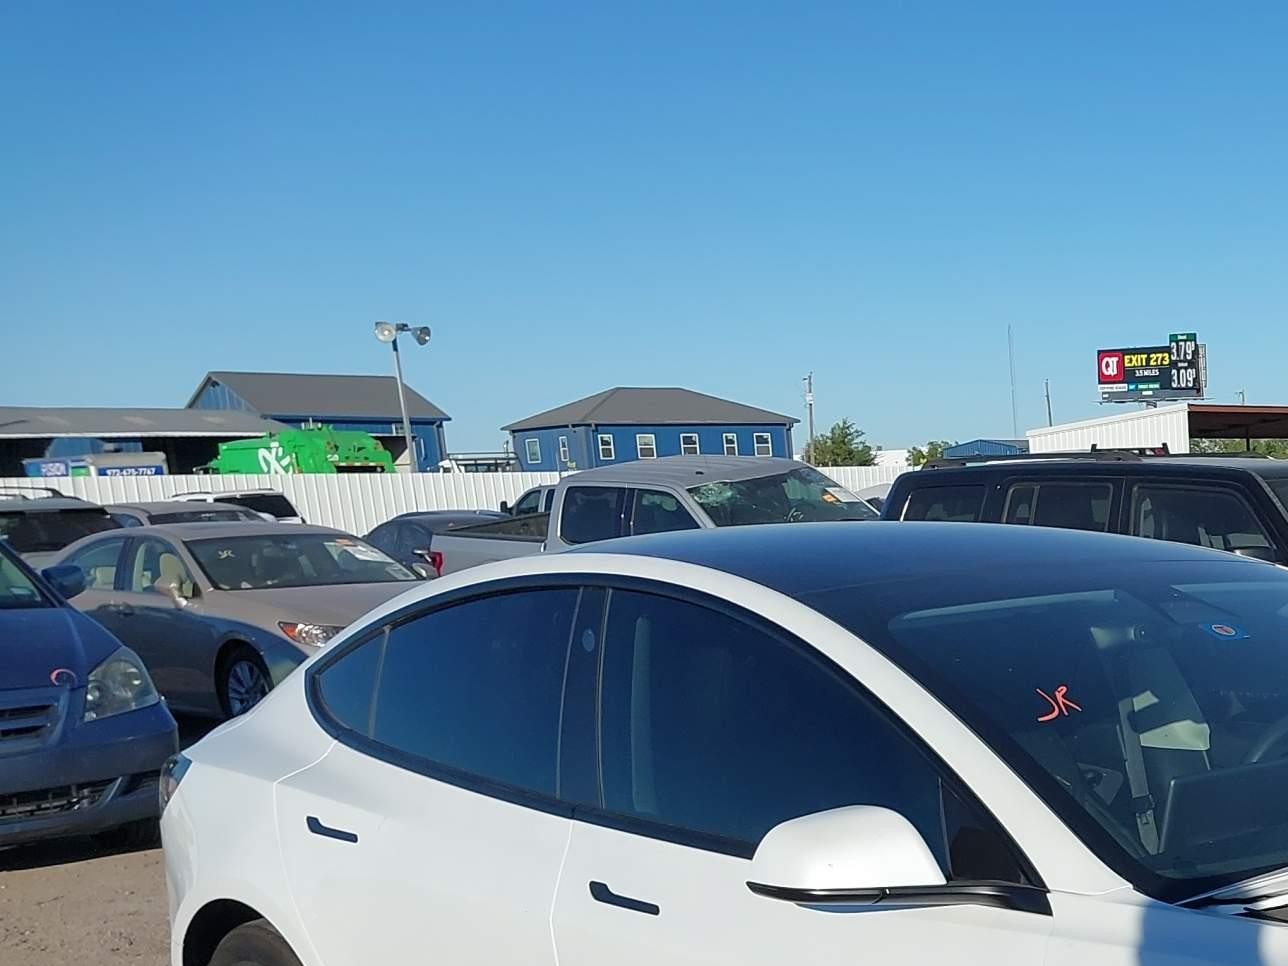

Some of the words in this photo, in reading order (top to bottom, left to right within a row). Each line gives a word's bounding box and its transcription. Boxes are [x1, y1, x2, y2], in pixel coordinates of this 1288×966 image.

[1101, 357, 1119, 376] QT
[1125, 354, 1147, 367] EXIT
[1150, 353, 1169, 366] 273
[1144, 369, 1160, 377] MILES
[1036, 685, 1082, 722] JR
